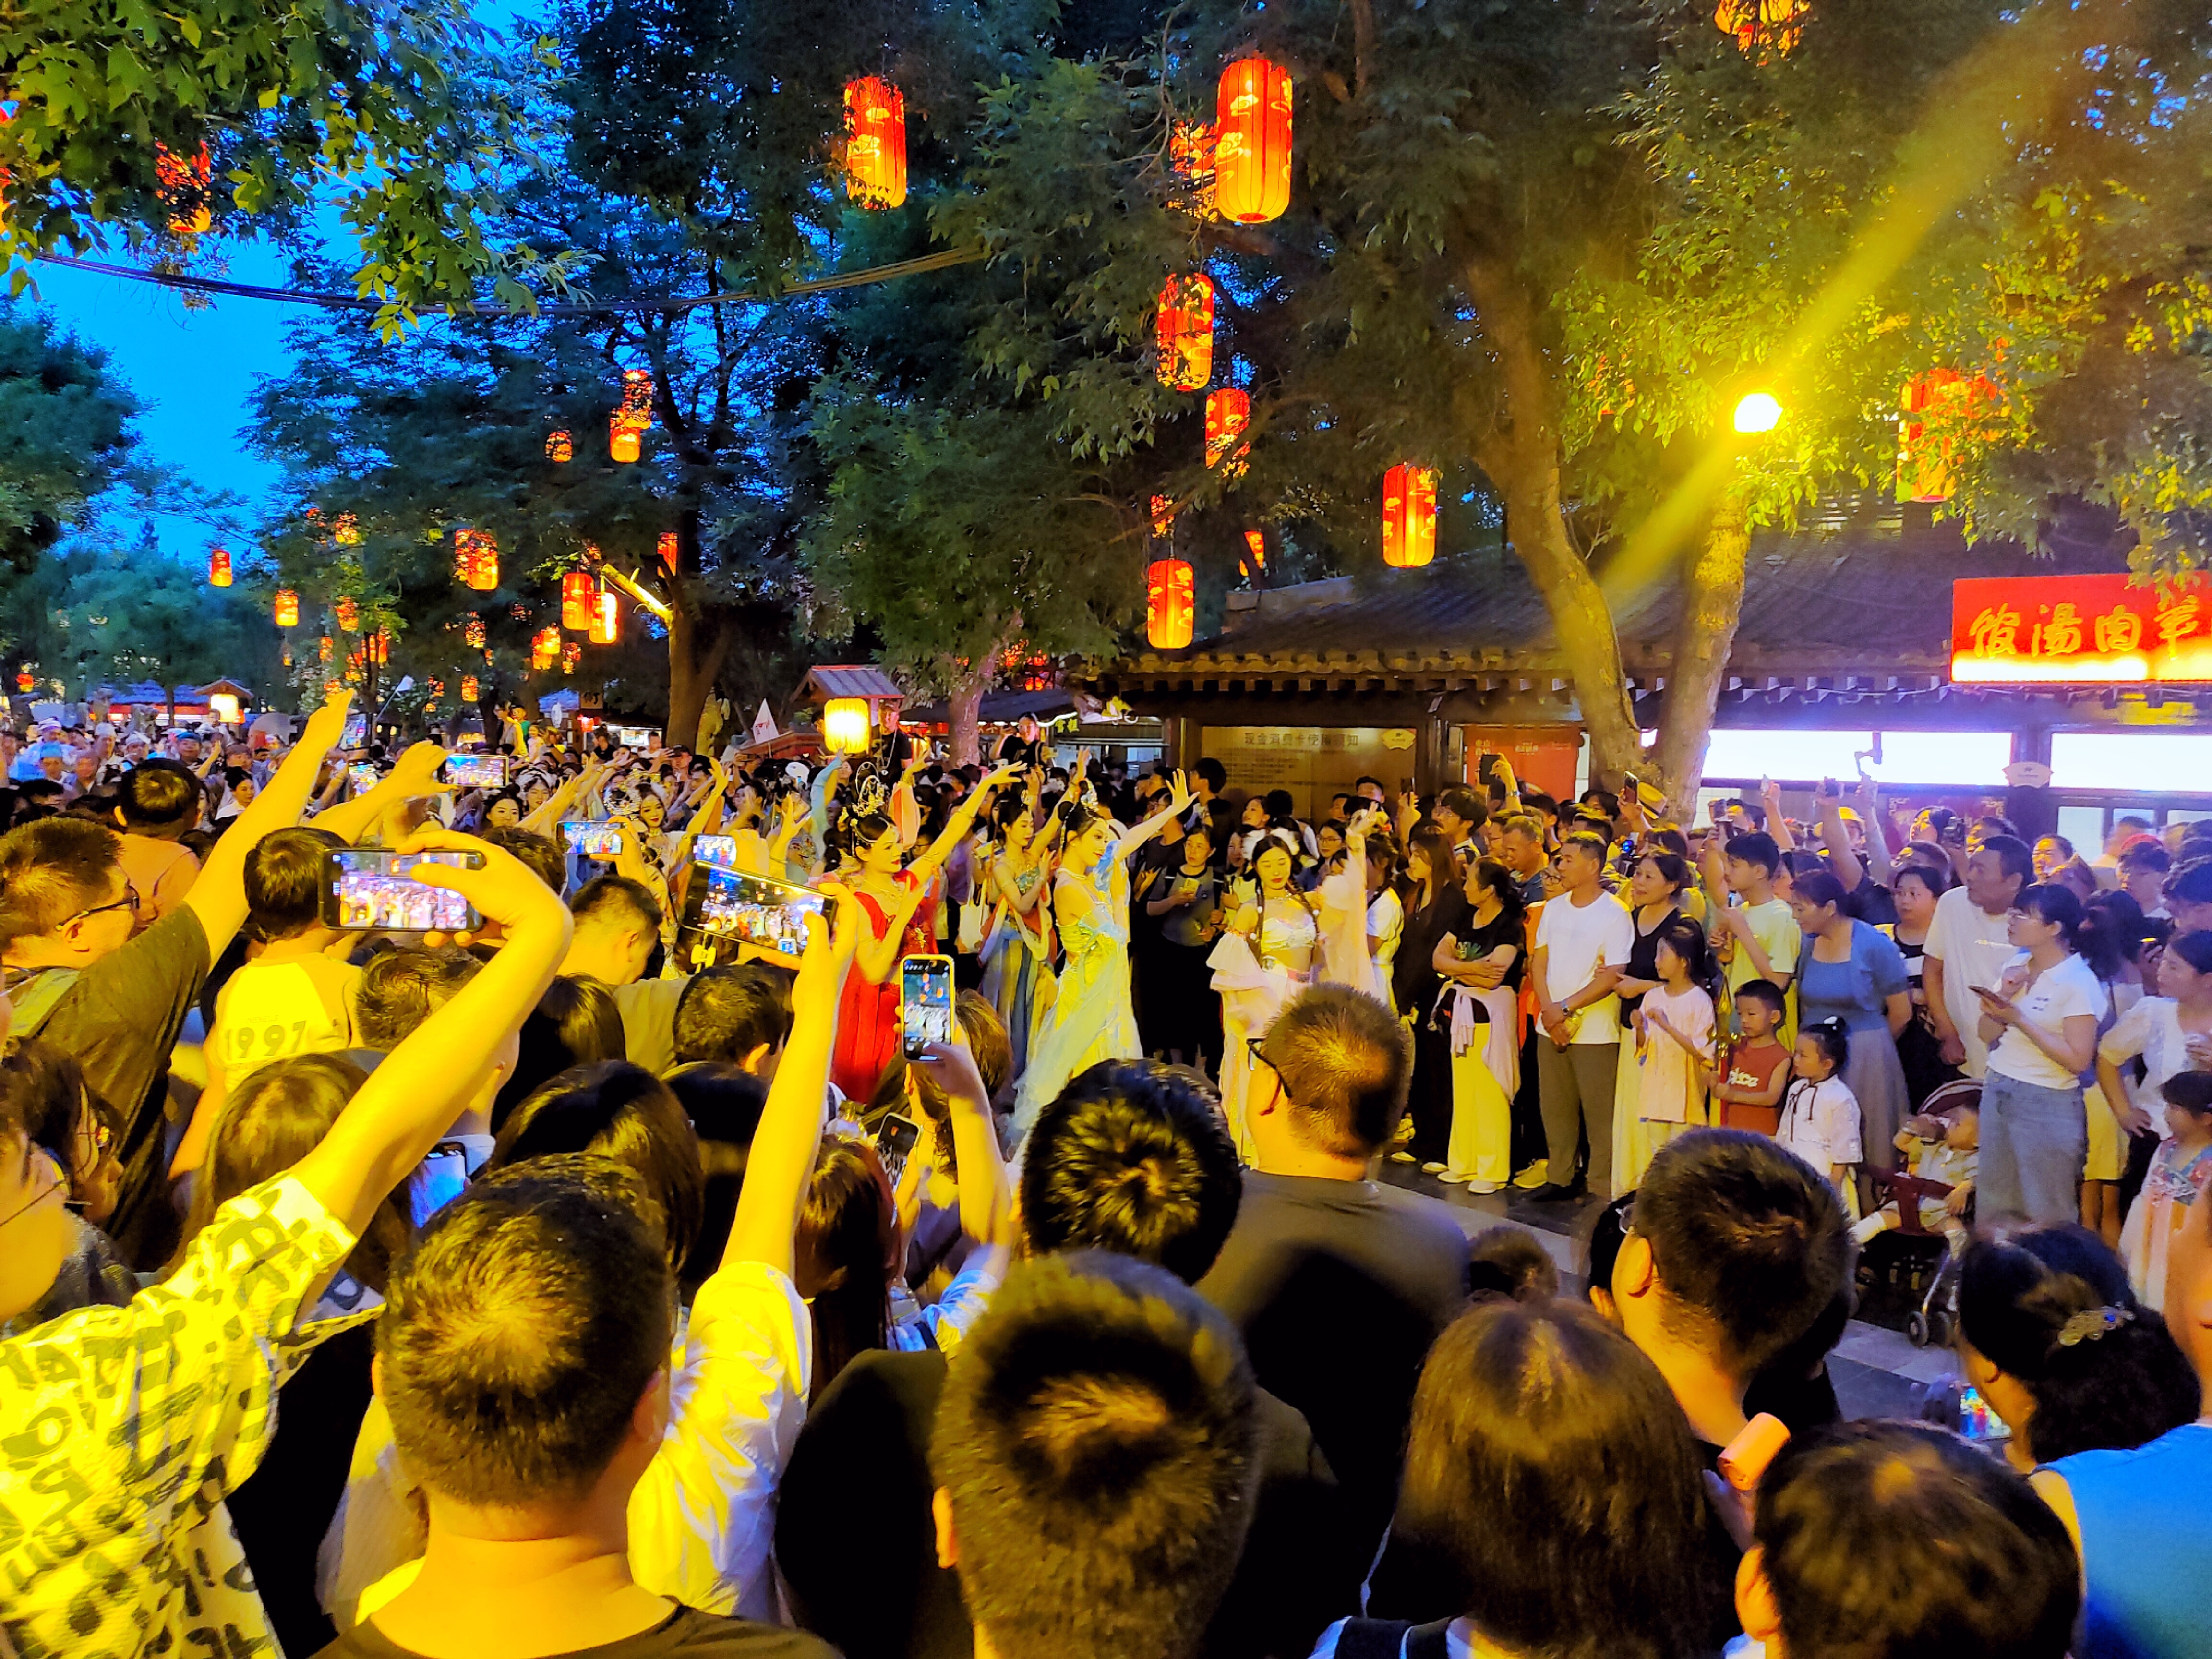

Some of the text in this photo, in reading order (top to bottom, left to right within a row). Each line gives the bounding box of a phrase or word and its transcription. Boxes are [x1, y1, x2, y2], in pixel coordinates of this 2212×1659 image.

[1244, 733, 1358, 746] 现金消费卡使用知
[226, 1021, 306, 1060] 1997
